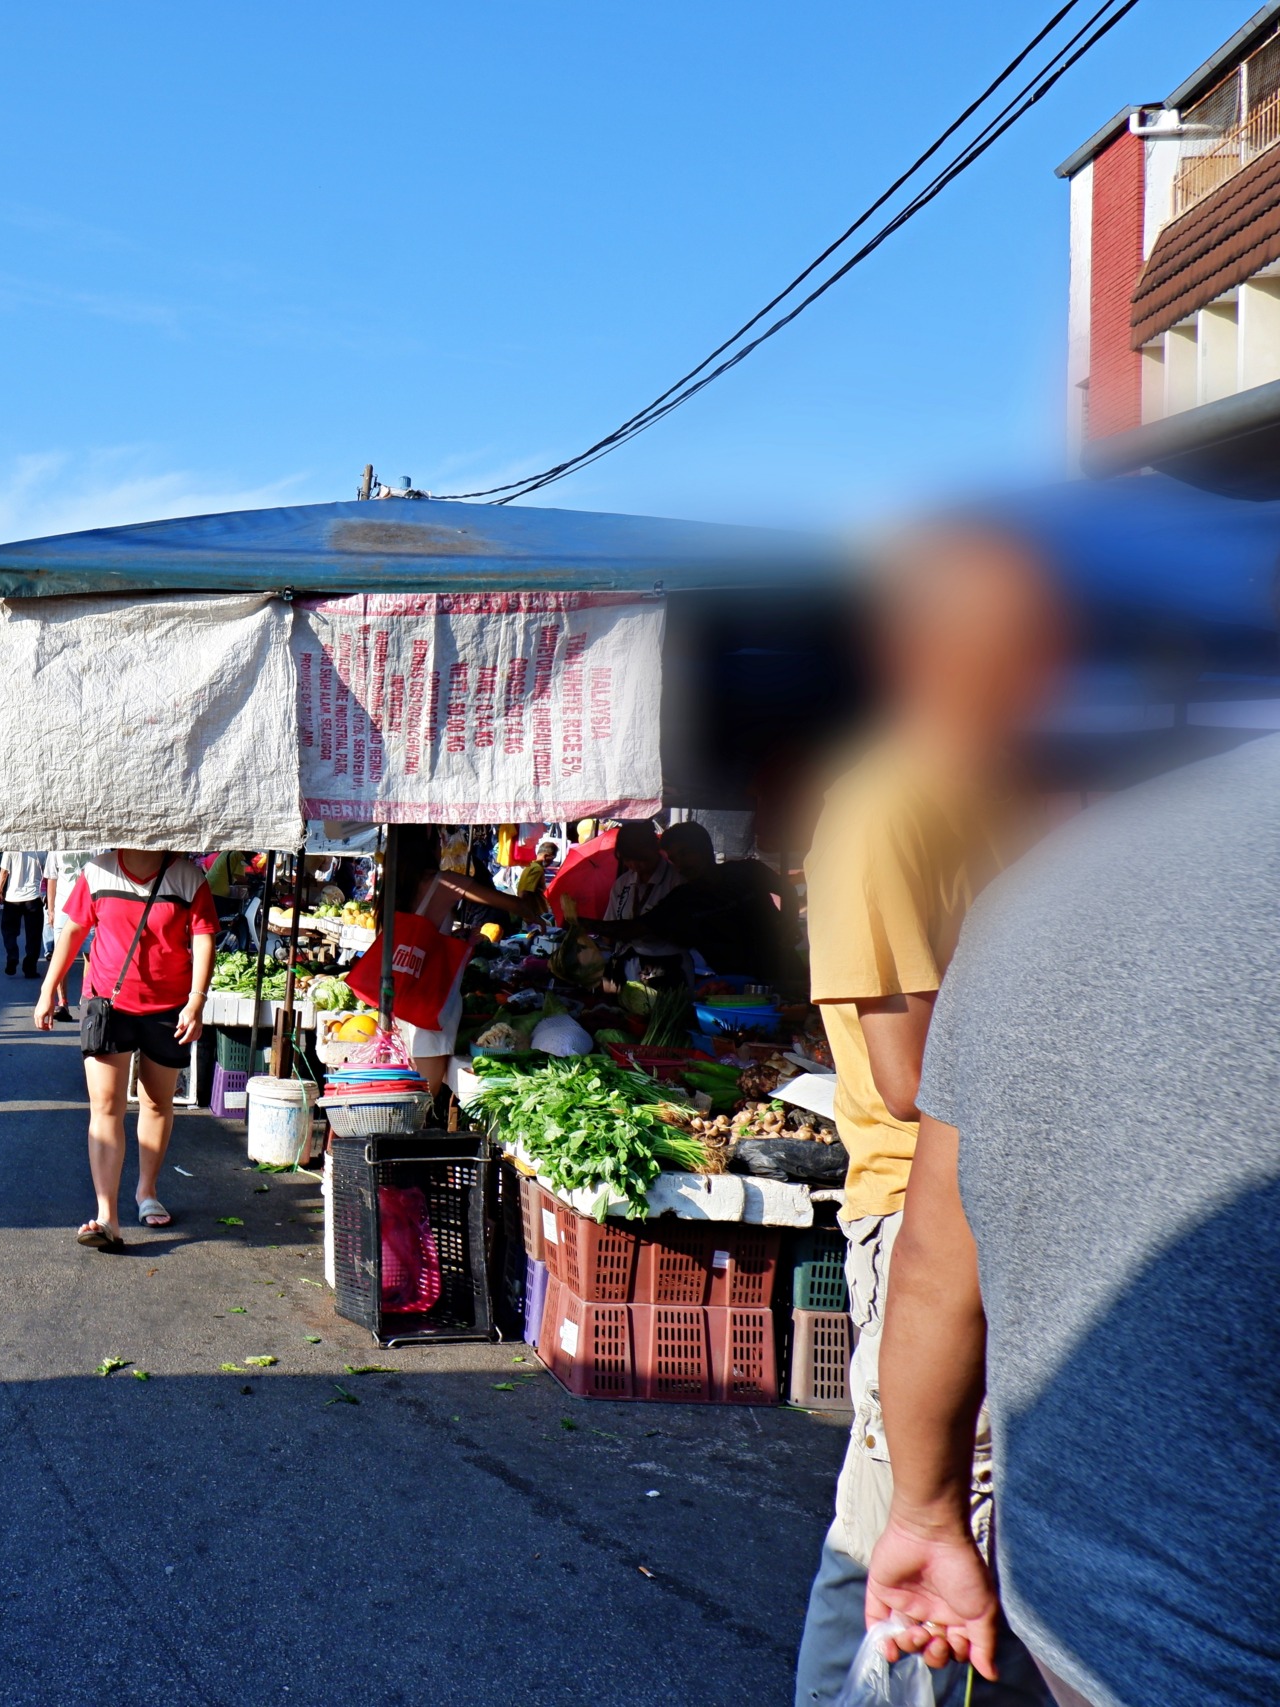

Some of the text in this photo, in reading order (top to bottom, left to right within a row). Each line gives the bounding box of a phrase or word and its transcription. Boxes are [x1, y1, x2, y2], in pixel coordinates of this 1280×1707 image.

[410, 640, 428, 679] BERNAS
[535, 624, 560, 674] SURVEYOR
[319, 668, 333, 690] SHAH
[448, 662, 469, 692] NETT
[476, 665, 498, 695] TARE
[505, 657, 528, 696] GROSS
[532, 674, 552, 700] NAME
[300, 652, 314, 748] PRODUCE OF THAILAND
[367, 630, 389, 783] PADIBERAS NASIONAL BERHAD (BERNAS)
[389, 674, 405, 720] IMPORTED
[426, 671, 440, 724] CONTRACT
[561, 632, 587, 777] THAI WHITE RICE 5%
[590, 667, 612, 740] MALAYSIA
[334, 705, 349, 749] INDUSTRIAL
[388, 722, 402, 734] BY
[424, 727, 438, 741] NO
[446, 703, 466, 733] 50.00
[475, 704, 494, 728] 0.14
[504, 703, 524, 735] 50.14
[532, 708, 551, 745] BUREAU
[319, 717, 333, 761] SELANGOR
[352, 739, 365, 775] SEKSYEN
[446, 735, 466, 753] KG
[474, 731, 494, 748] KG
[503, 737, 524, 755] KG
[532, 748, 552, 788] VERITAS
[320, 803, 388, 818] BERNAS
